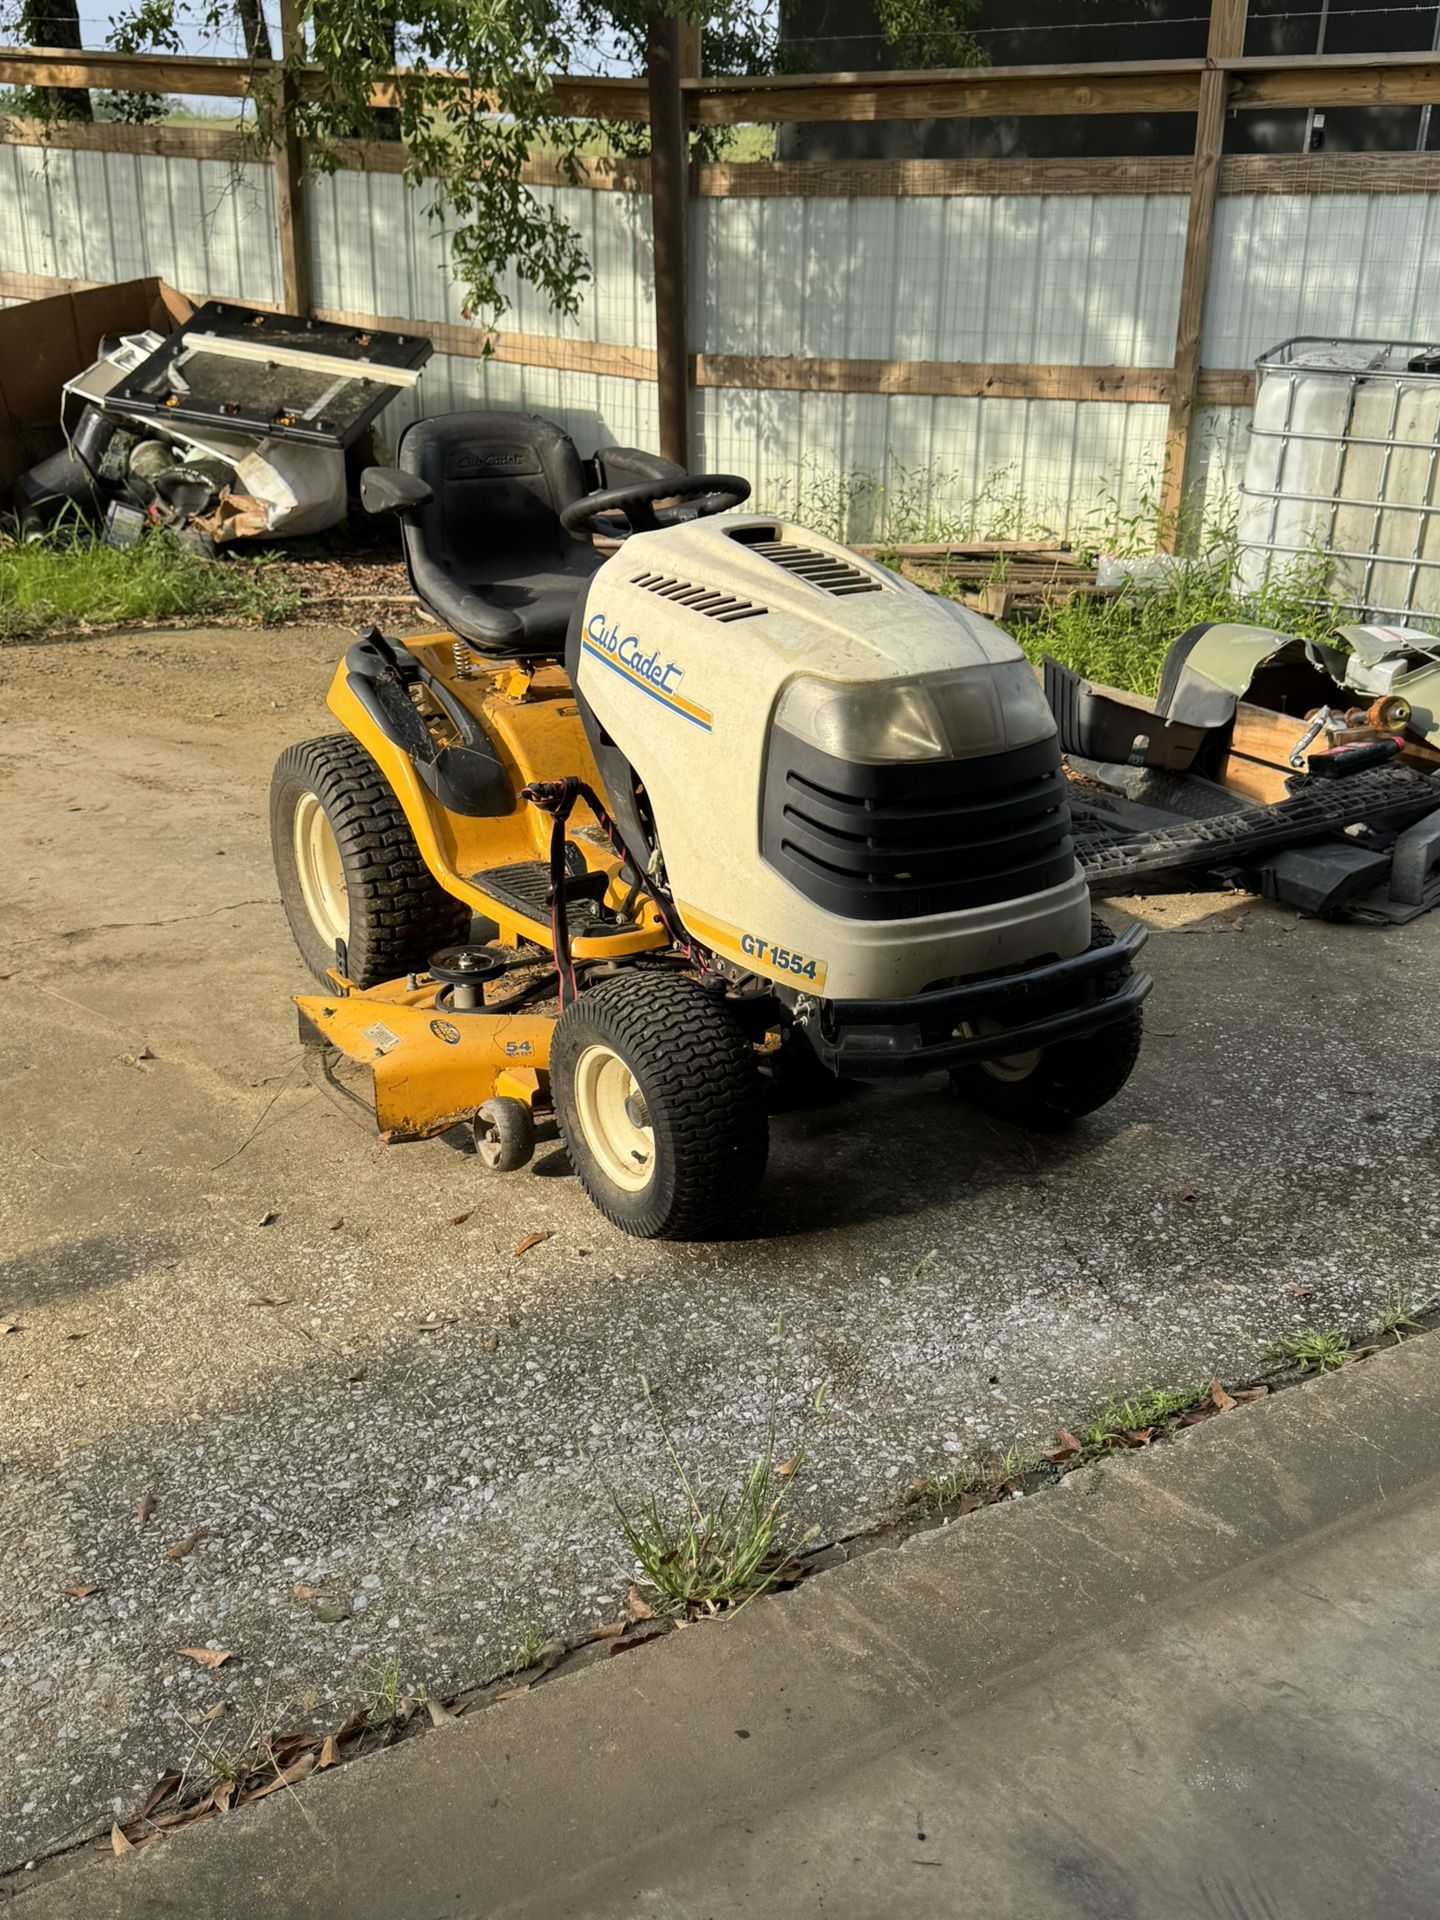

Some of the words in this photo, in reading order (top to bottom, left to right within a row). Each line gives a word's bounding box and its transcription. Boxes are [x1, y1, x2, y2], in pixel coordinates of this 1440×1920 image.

[588, 613, 619, 653] Cub
[618, 636, 683, 695] Cadet
[741, 933, 768, 959] GT
[770, 946, 817, 980] 1554
[505, 1041, 531, 1052] 54
